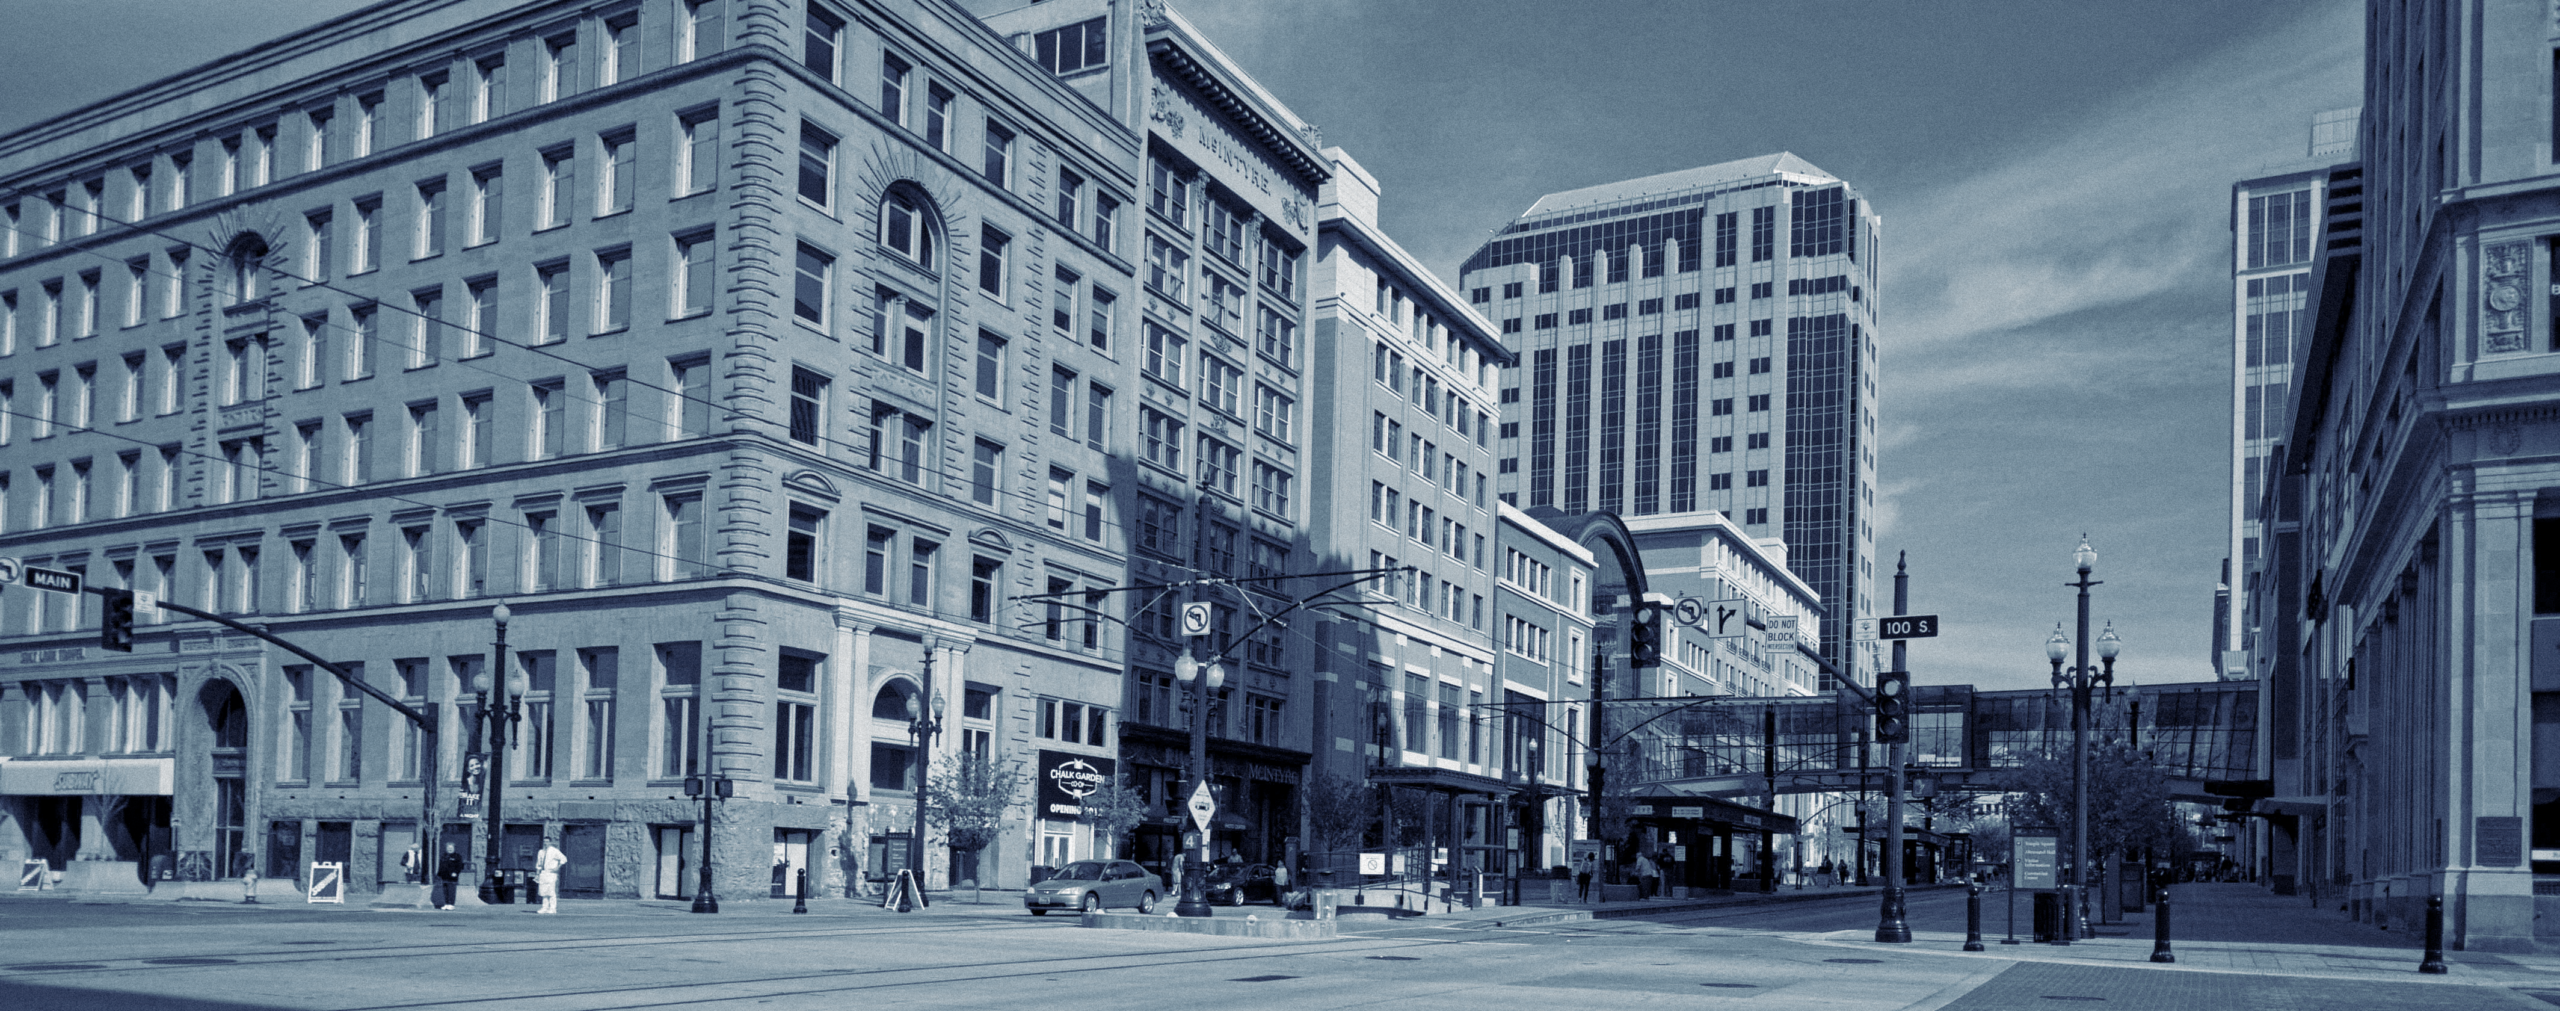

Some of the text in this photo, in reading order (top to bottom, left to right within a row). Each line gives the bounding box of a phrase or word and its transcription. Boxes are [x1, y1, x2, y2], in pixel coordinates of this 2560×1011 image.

[34, 572, 71, 590] MAIN
[1768, 619, 1796, 629] DO NOT
[1886, 621, 1911, 635] 100
[1919, 620, 1931, 633] S.
[1767, 632, 1795, 642] BLOCK
[53, 769, 100, 791] SUBWAY
[1050, 768, 1106, 784] CHALK GARDEN
[1050, 803, 1082, 815] OPENING
[1185, 835, 1195, 848] 4
